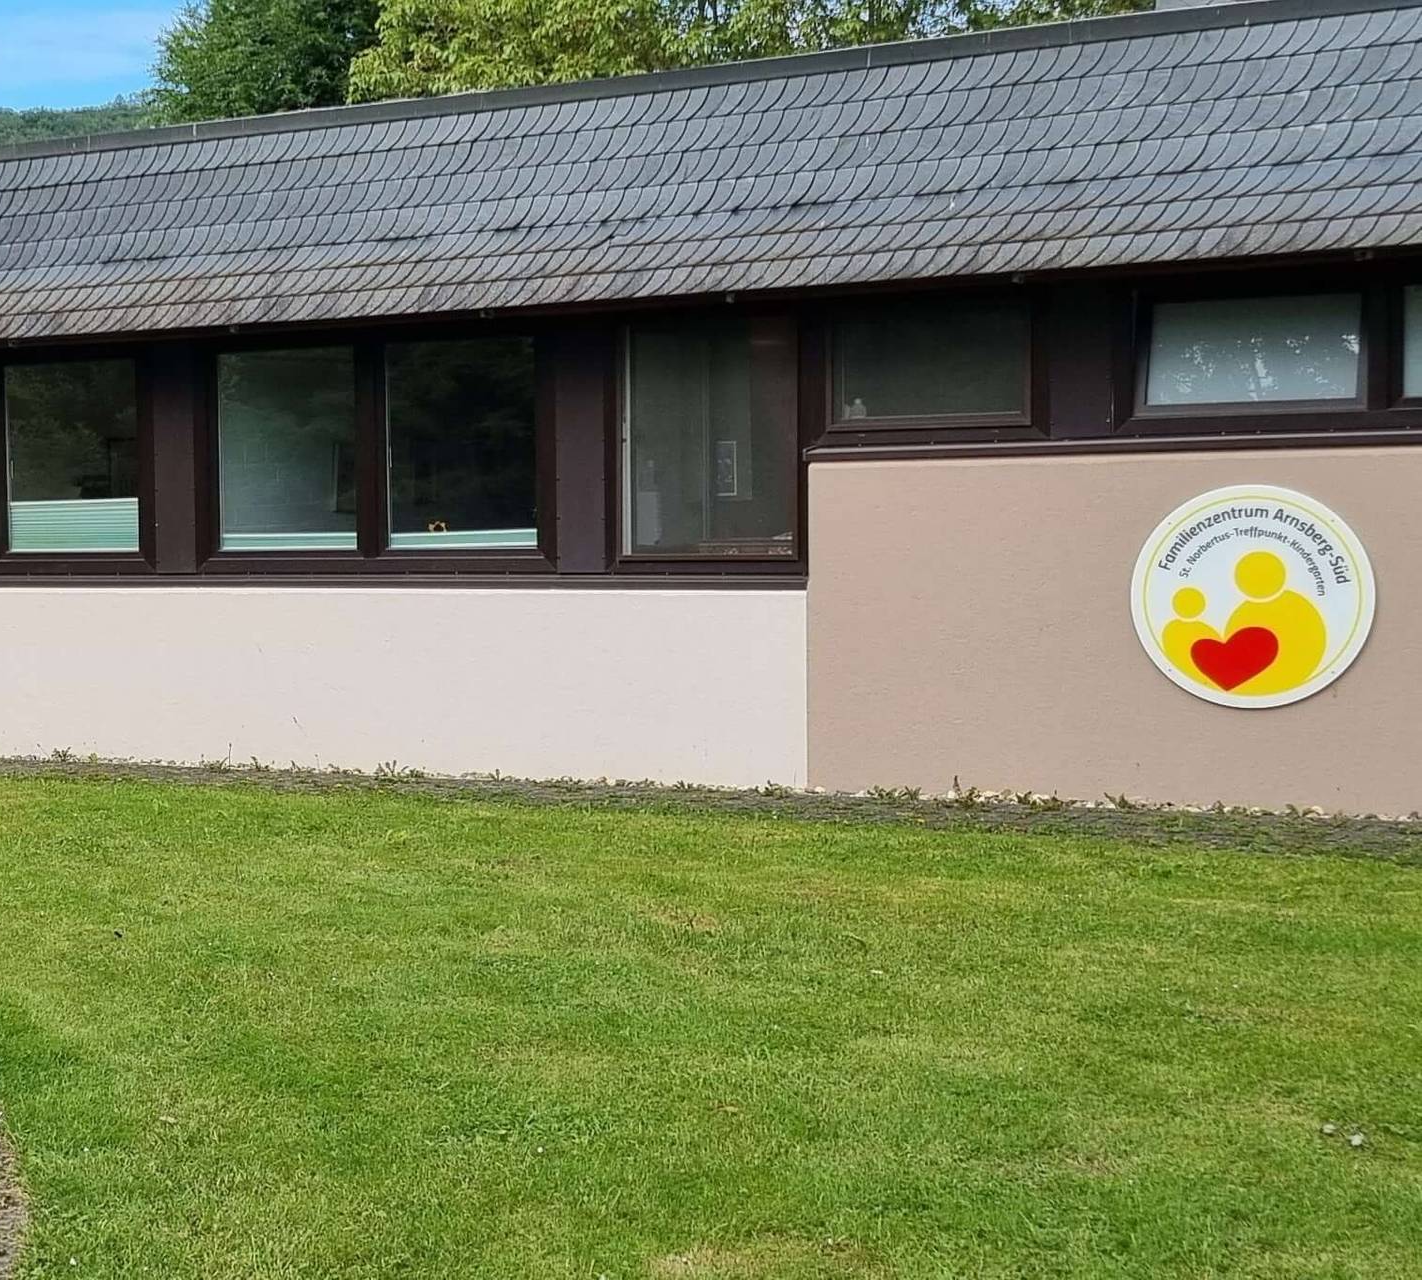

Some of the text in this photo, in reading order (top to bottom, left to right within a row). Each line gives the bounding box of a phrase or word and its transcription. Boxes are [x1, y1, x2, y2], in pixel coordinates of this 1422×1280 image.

[1158, 507, 1351, 585] Familienzentrum Arnsberg-Süd
[1179, 526, 1326, 597] St. Norbertus-Treffpunkt-Kindergarten
